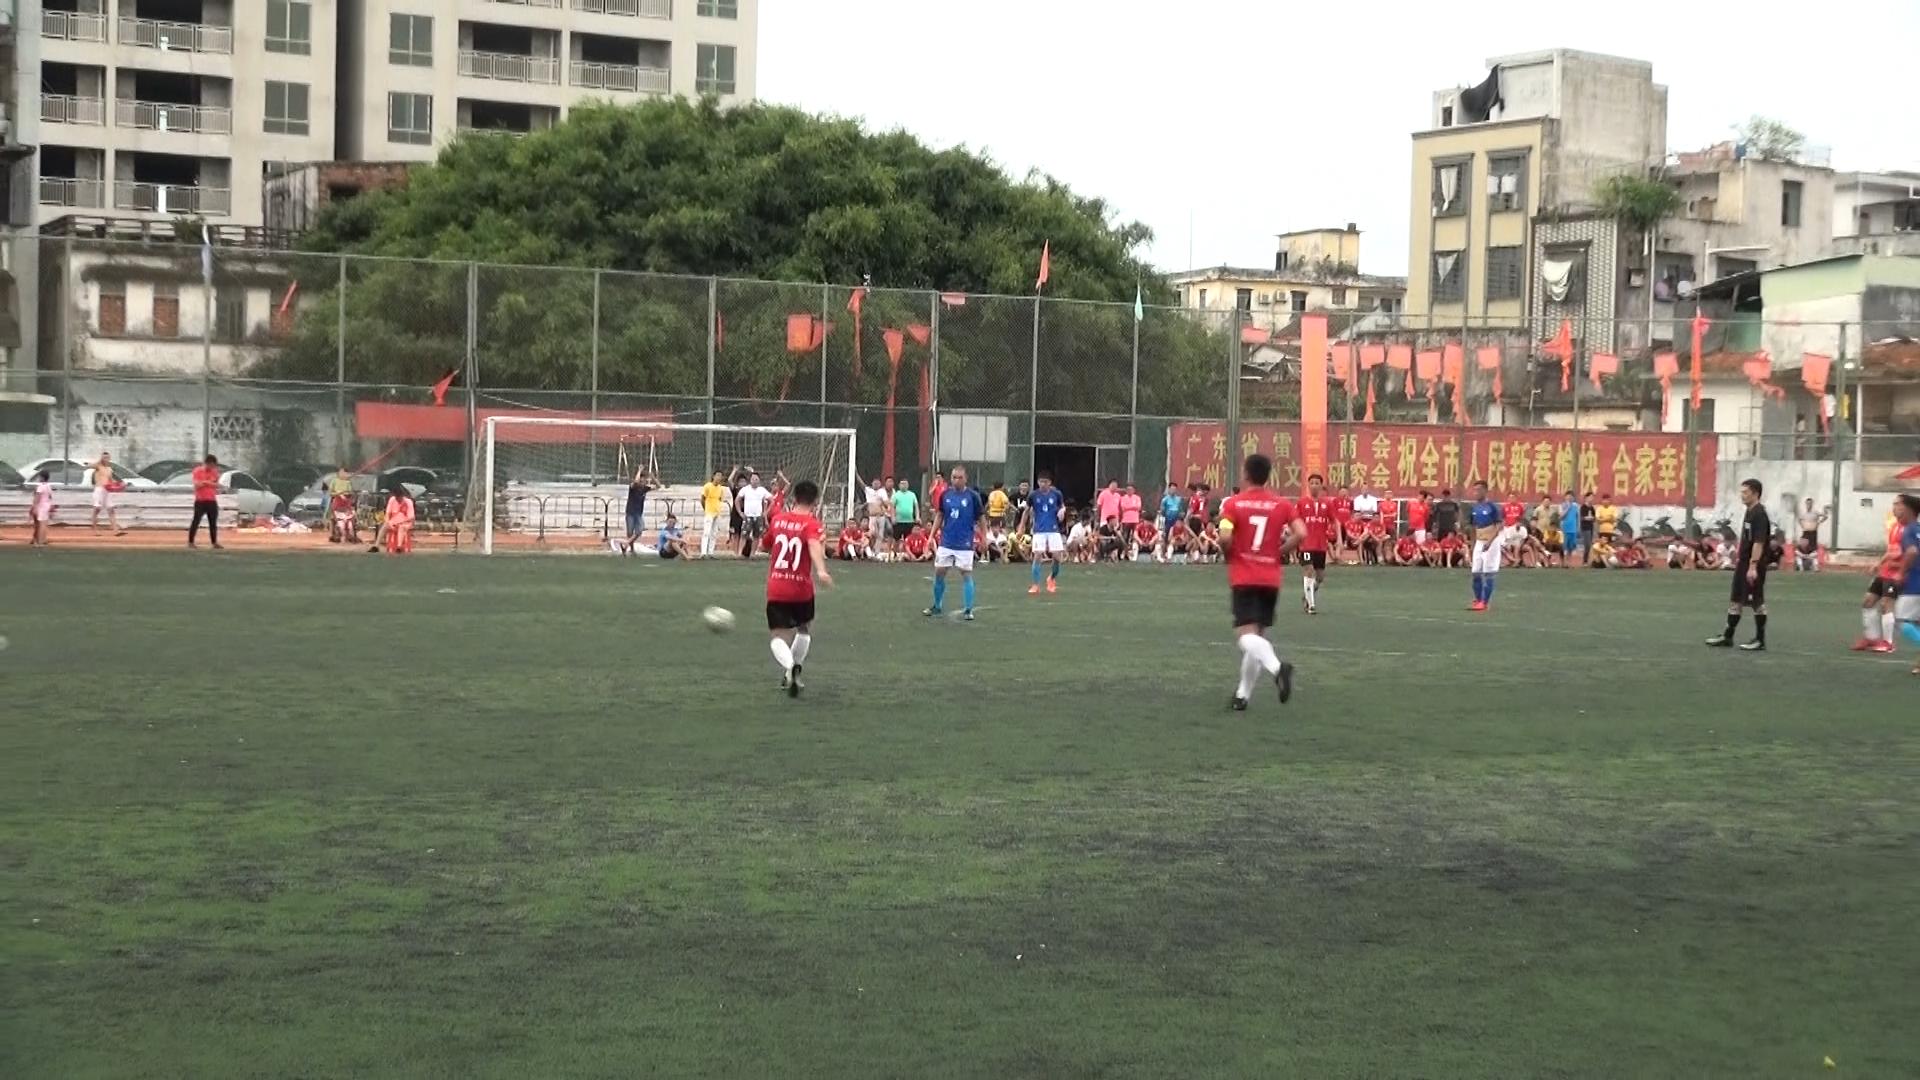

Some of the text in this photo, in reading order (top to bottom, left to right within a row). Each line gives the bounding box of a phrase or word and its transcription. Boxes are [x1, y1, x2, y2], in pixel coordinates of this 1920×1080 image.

[1186, 432, 1391, 459] 广东省雷商会
[1248, 515, 1269, 551] 7
